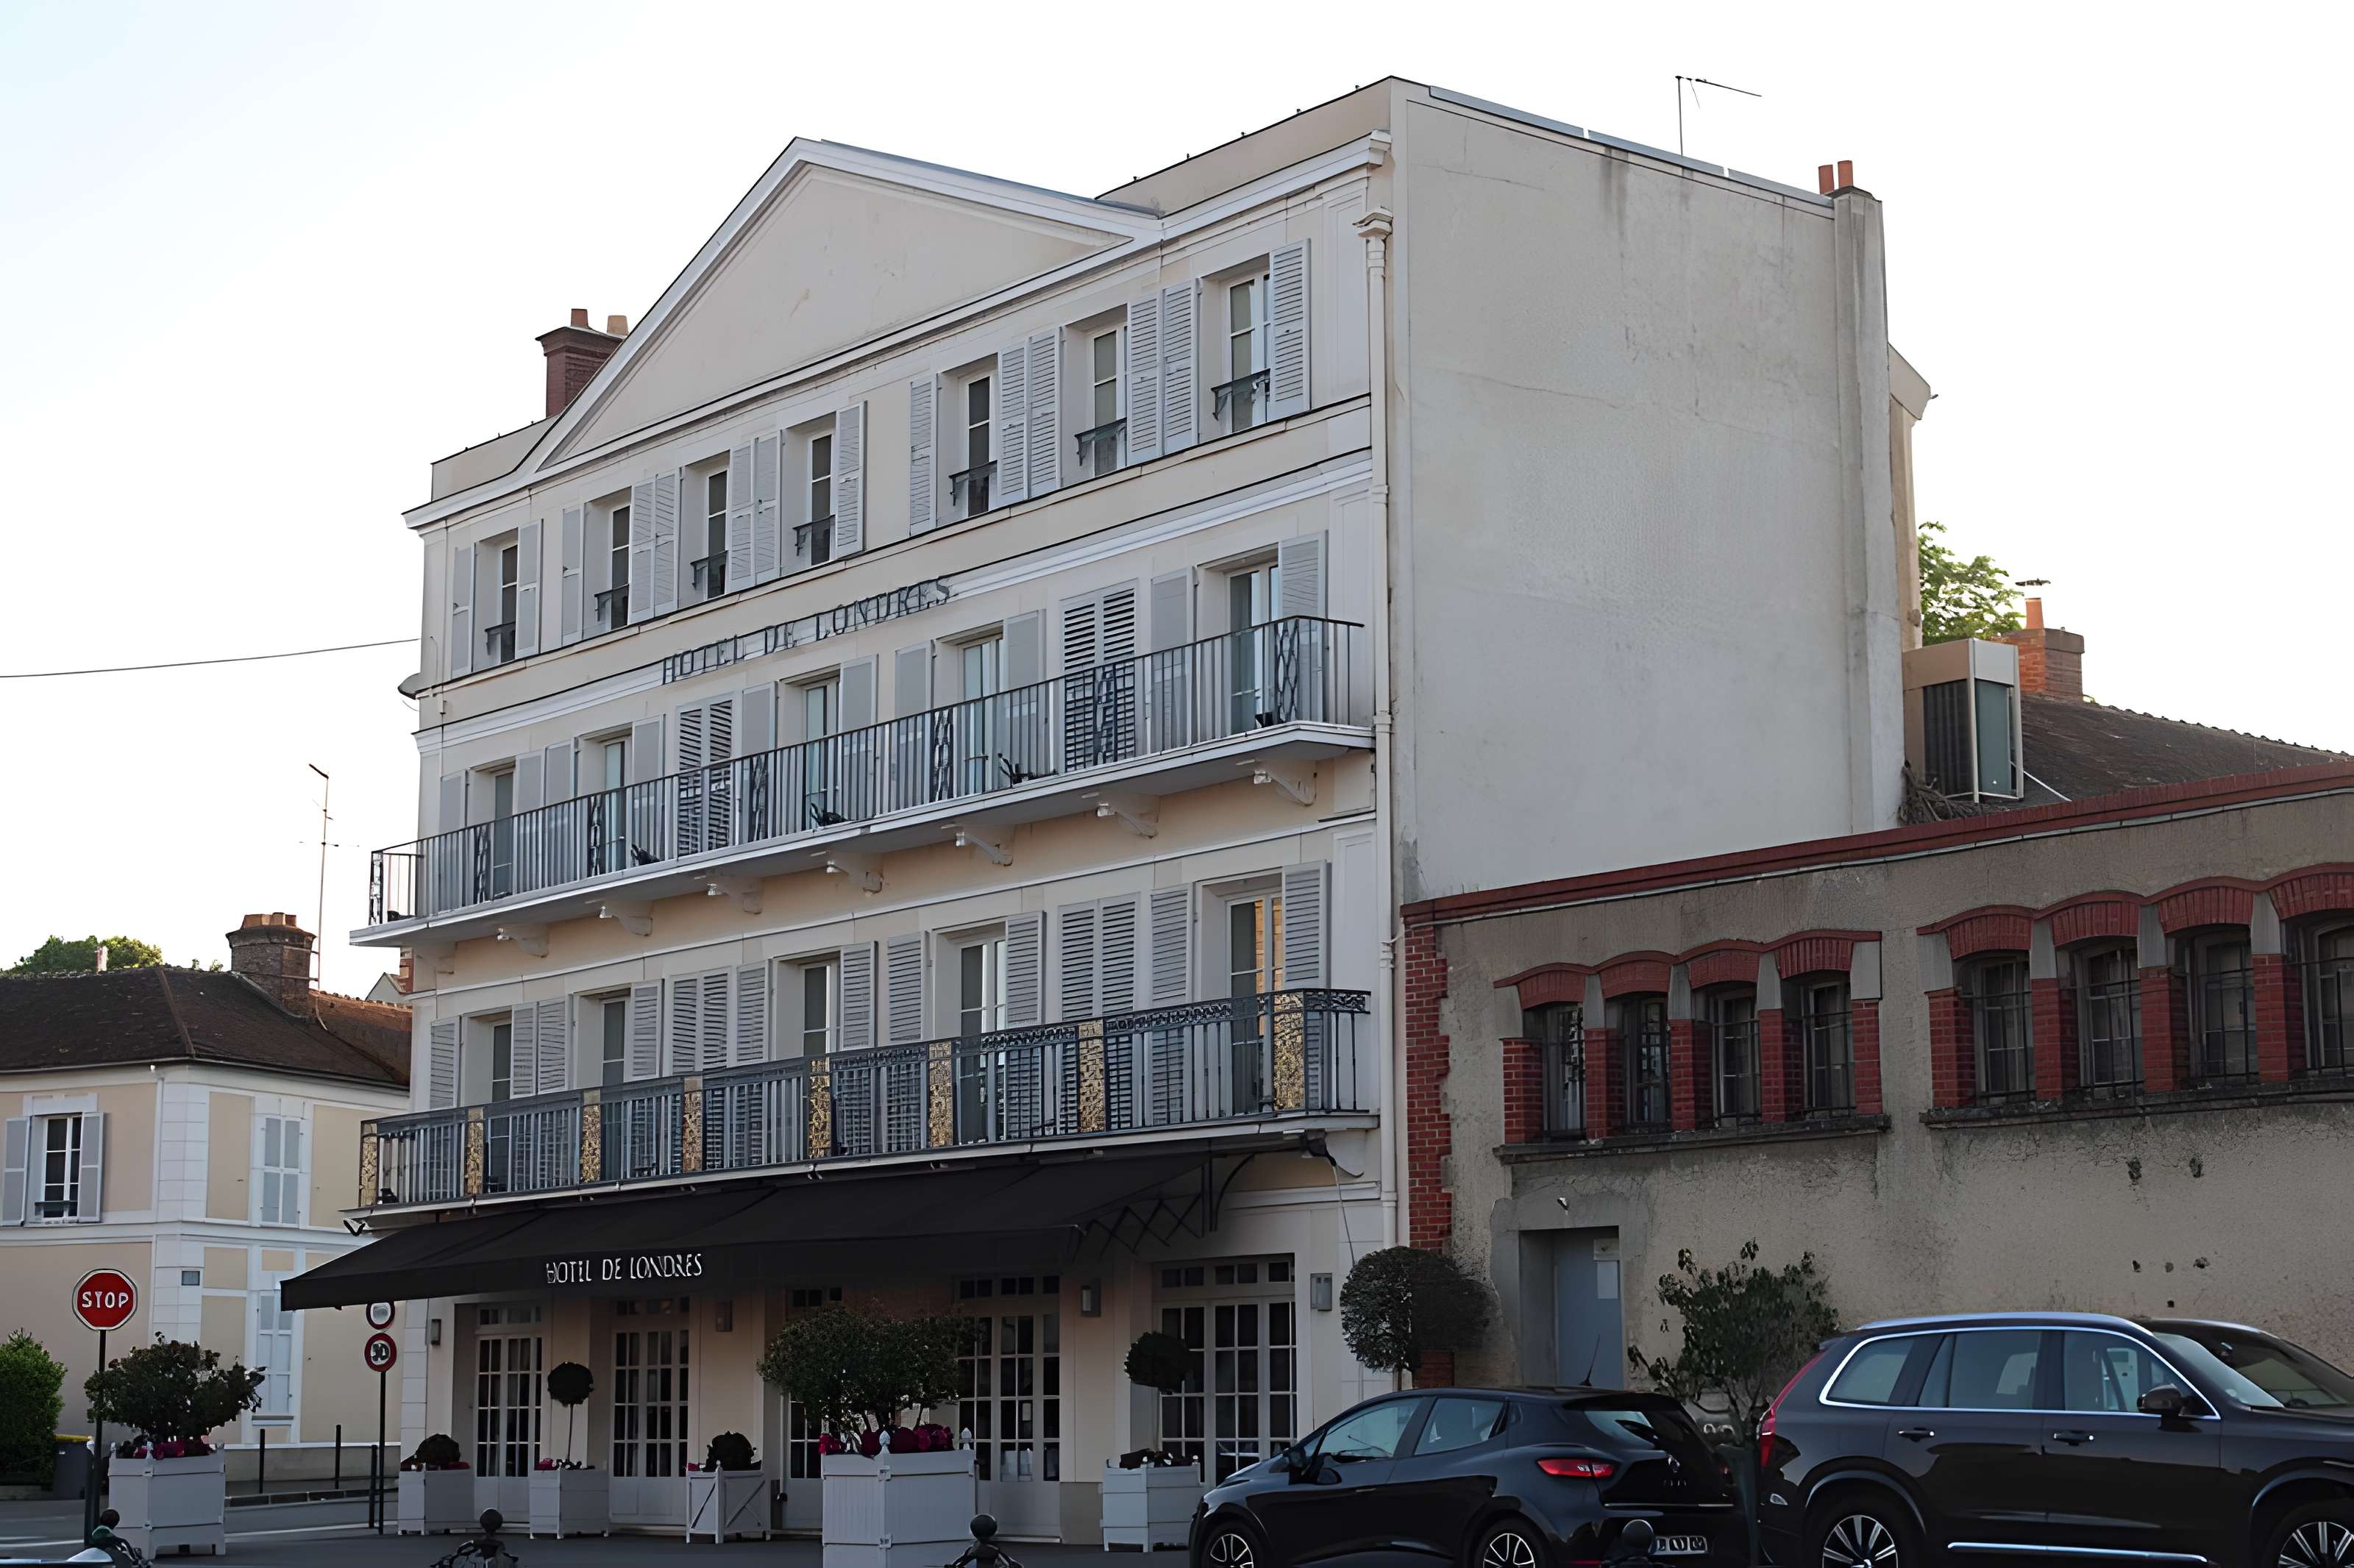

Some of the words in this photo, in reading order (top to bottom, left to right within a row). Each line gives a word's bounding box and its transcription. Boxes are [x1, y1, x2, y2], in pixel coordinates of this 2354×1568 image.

[546, 1260, 592, 1284] HOTEL
[602, 1258, 622, 1280] DE
[630, 1253, 702, 1280] LONDRES
[82, 1291, 129, 1308] STOP
